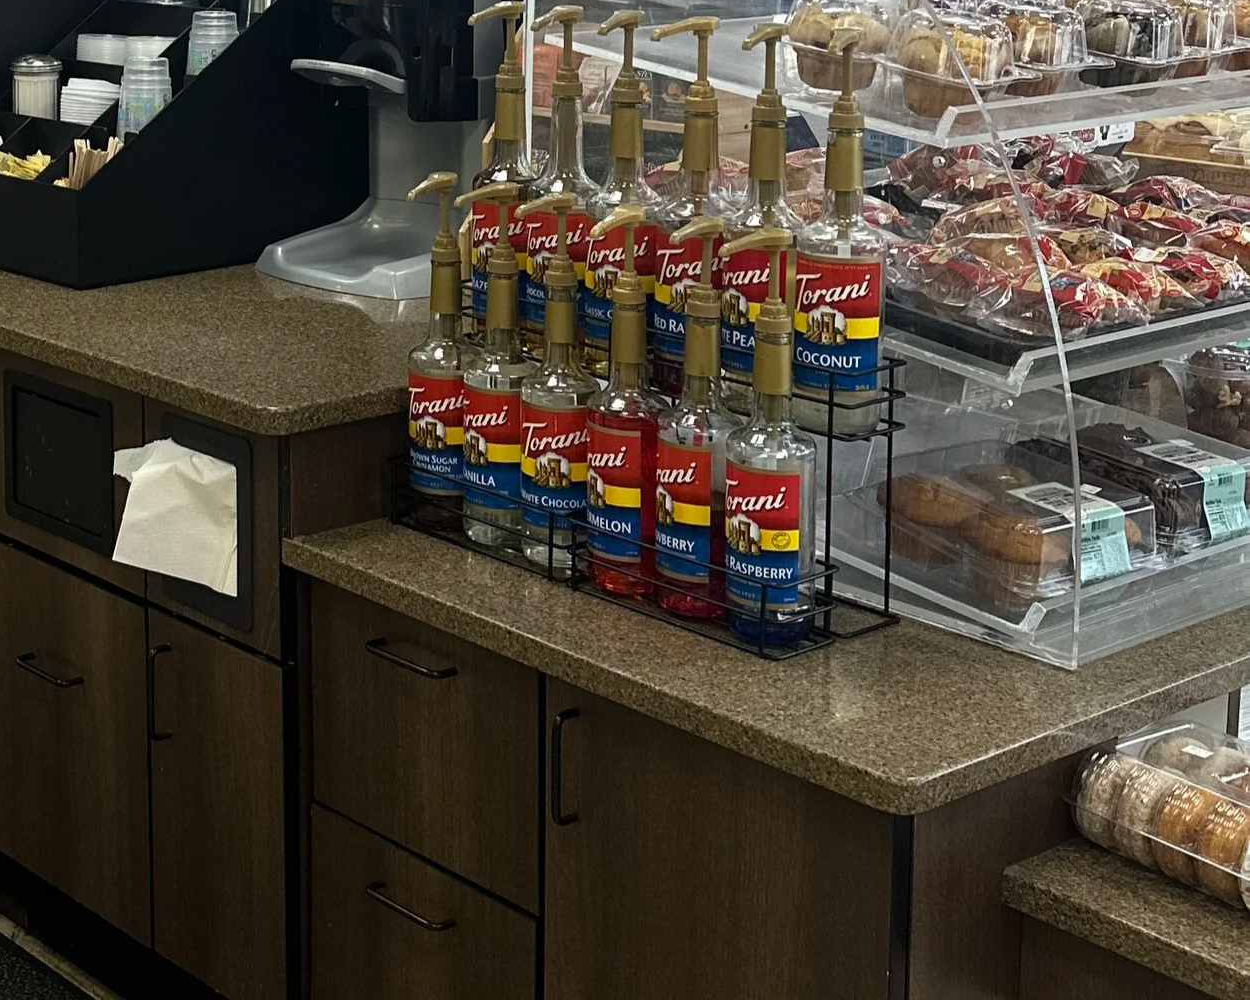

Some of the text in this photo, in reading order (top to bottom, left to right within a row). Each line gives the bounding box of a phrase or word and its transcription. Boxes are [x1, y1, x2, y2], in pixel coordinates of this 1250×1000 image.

[796, 273, 871, 313] Torani
[796, 347, 862, 368] COCONUT
[408, 387, 464, 421] Torani
[431, 454, 458, 465] SUGAR
[729, 555, 794, 580] RASPBERRY
